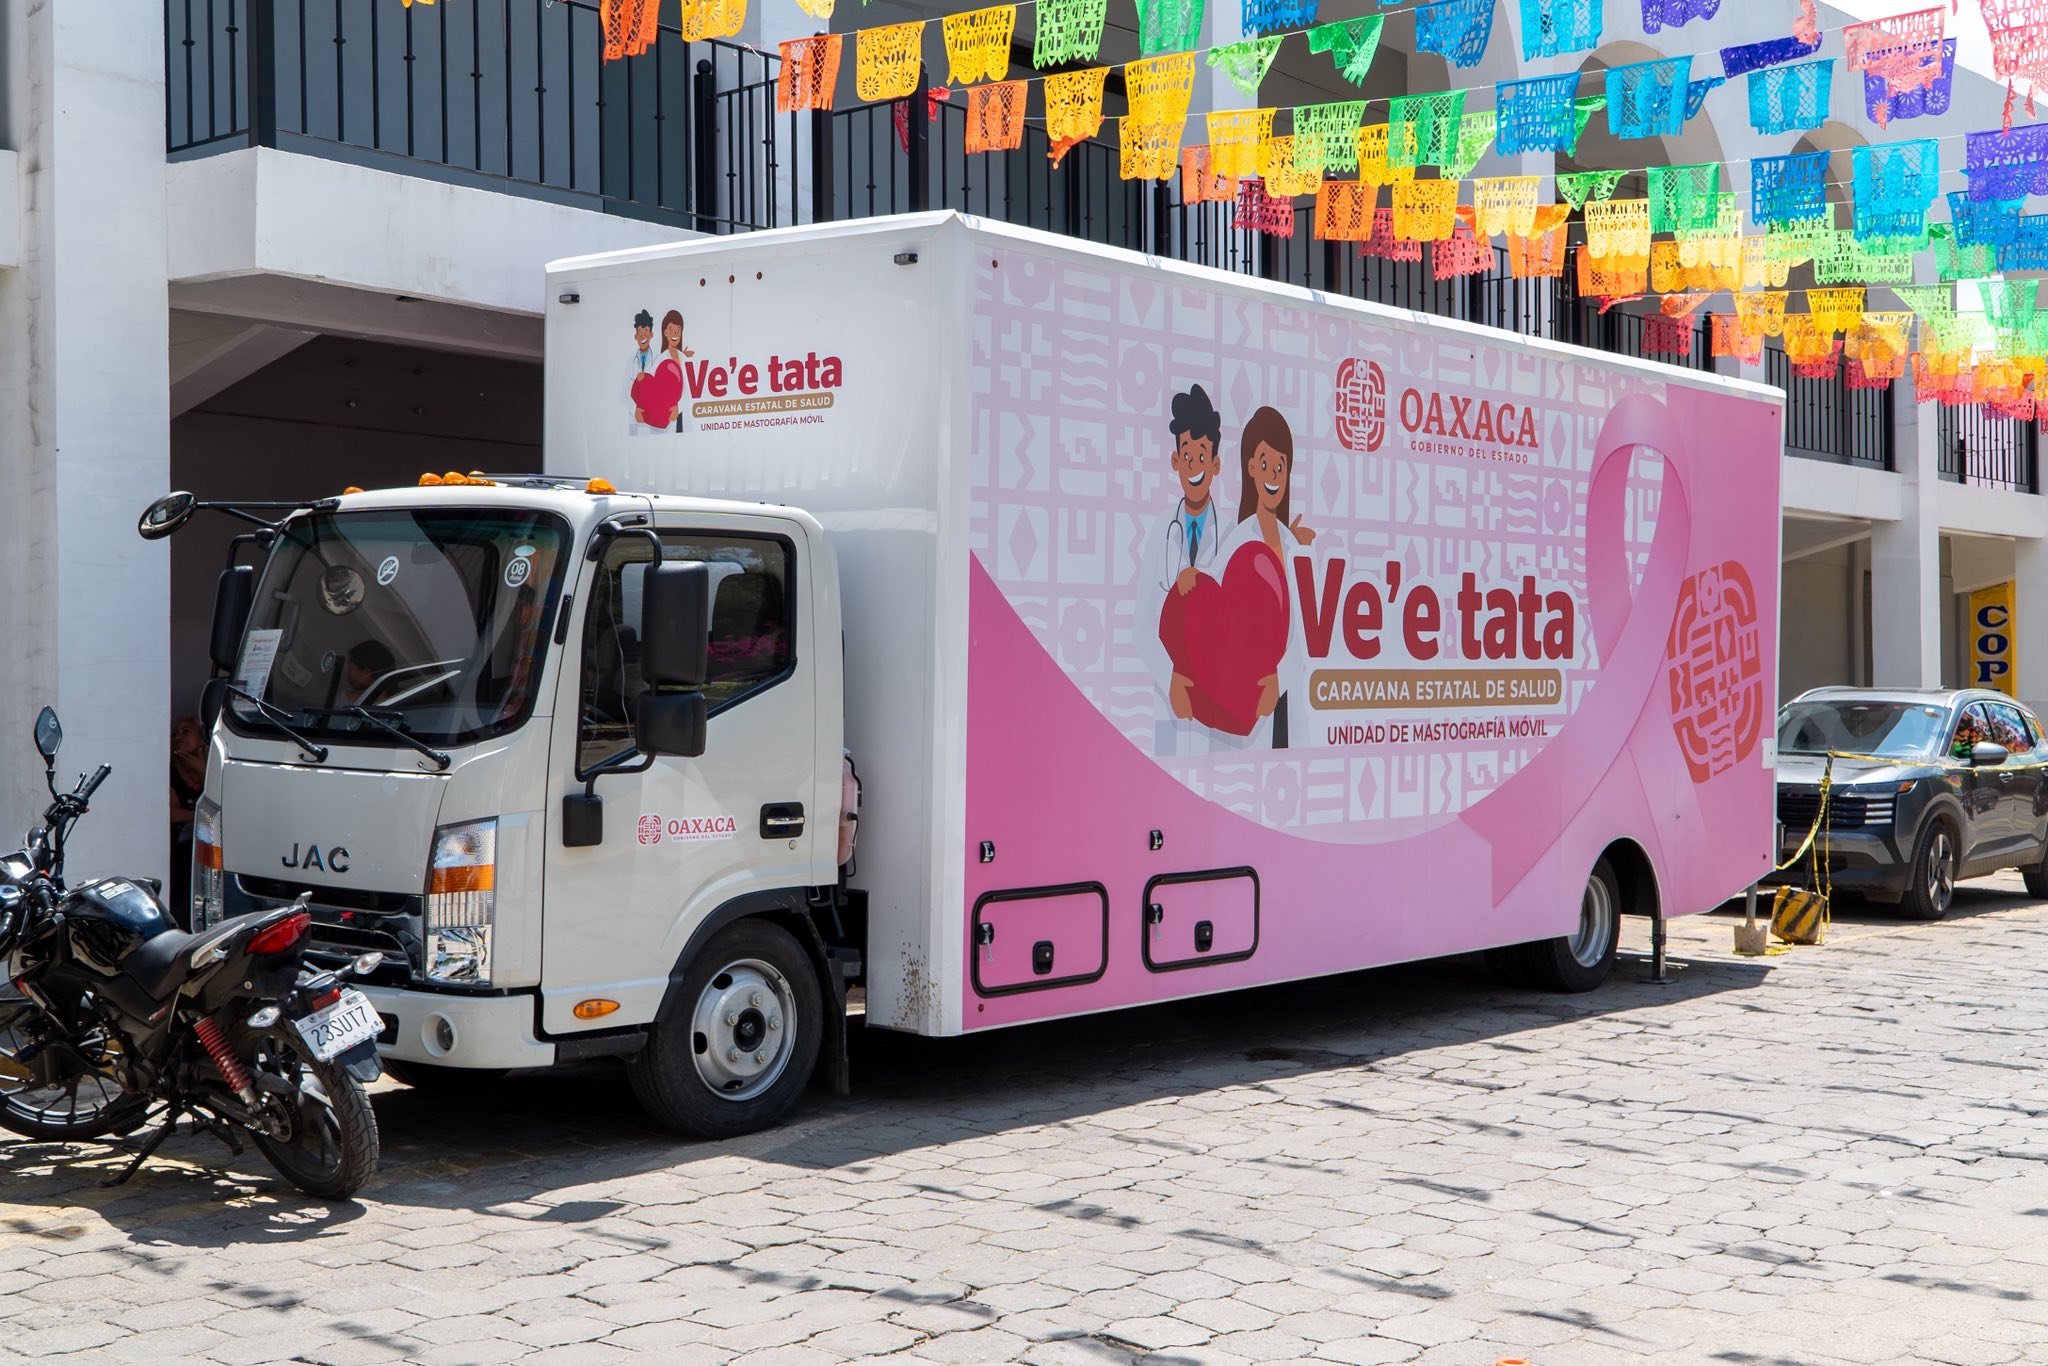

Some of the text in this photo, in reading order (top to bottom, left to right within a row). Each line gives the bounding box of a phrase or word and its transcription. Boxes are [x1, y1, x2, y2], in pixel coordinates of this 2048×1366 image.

[684, 352, 843, 399] Ve'e tata
[695, 396, 831, 415] CARAVANA ESTATAL DE SALUD
[1400, 387, 1539, 448] OAXACA
[700, 413, 825, 432] UNIDAD DE MASTOGRAFÍA MÓVIL
[1410, 440, 1529, 464] GOBIERNO DEL ESTADO
[510, 562, 526, 576] 08
[1293, 555, 1575, 661] Ve'e tata
[1976, 604, 2009, 692] COP
[1316, 678, 1557, 702] CARAVANA ESTATAL DE SALUD
[1327, 715, 1548, 746] UNIDAD DE MASTOGRAFÍA MÓVIL
[667, 817, 737, 836] OAXACA
[281, 842, 351, 873] JAC
[310, 1005, 368, 1047] 23SUT7
